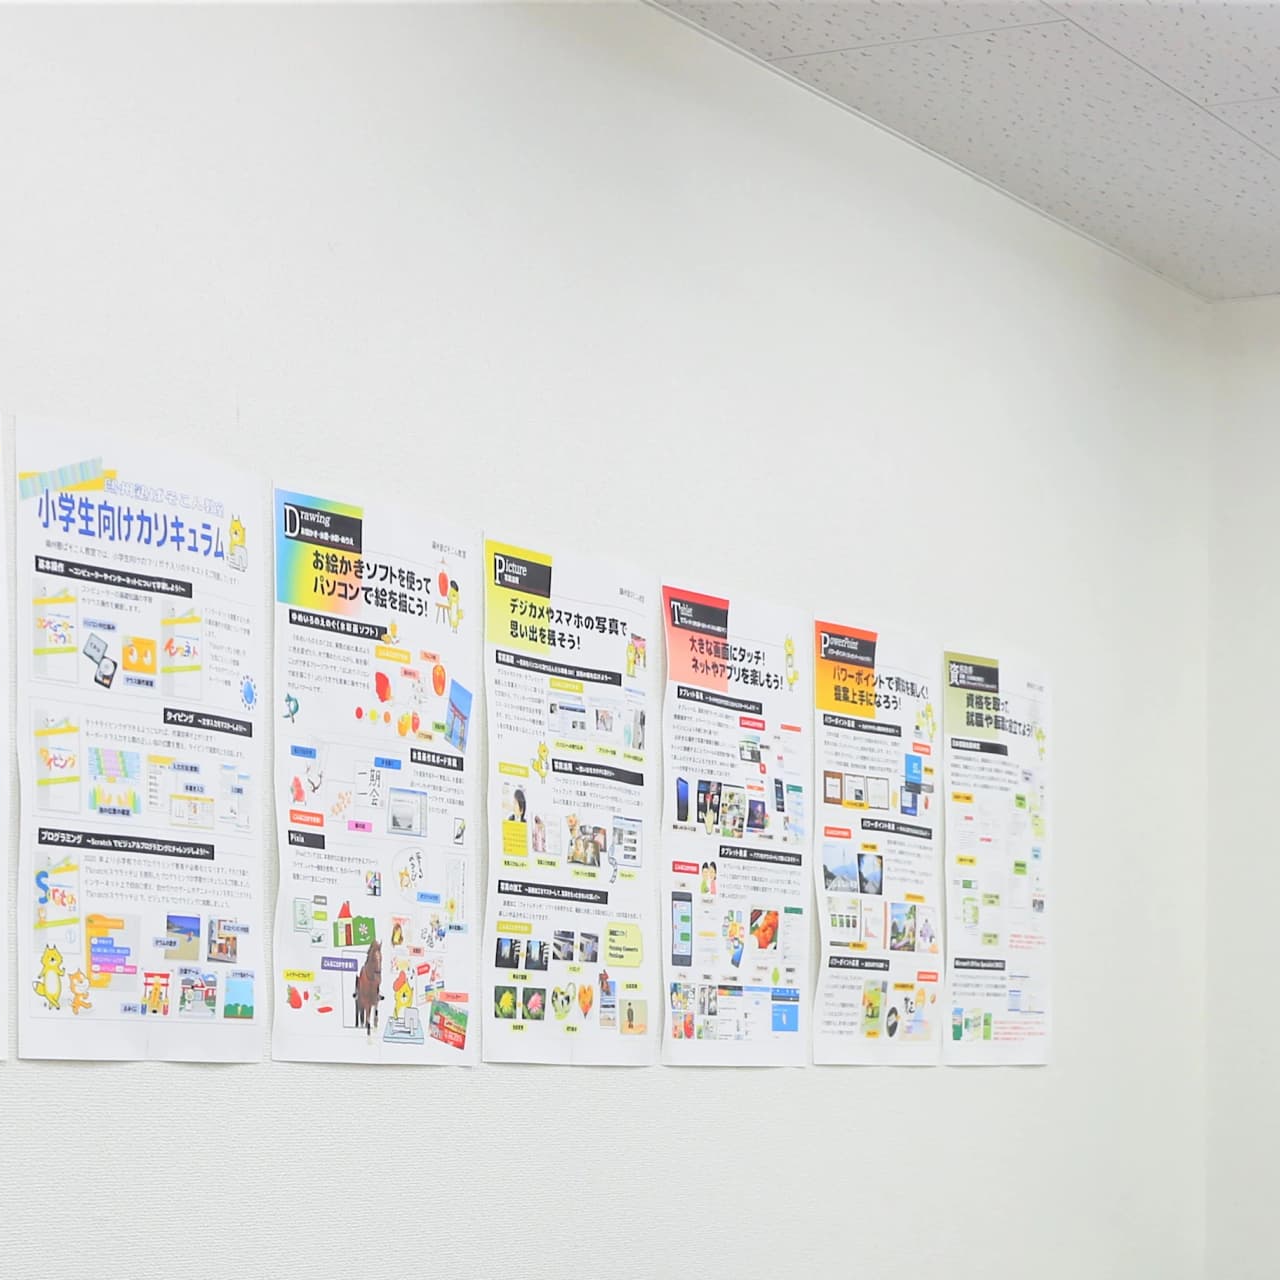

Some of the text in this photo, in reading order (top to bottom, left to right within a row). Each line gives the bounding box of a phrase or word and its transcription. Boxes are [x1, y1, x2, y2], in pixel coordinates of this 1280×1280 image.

[36, 487, 225, 560] 小学生向けカリキュラム
[284, 504, 331, 537] Drawing
[312, 550, 432, 595] お絵かきソフトを使って
[494, 554, 528, 585] Picture
[313, 575, 429, 618] パソコンで絵を描こう!
[509, 597, 628, 637] デジカメやスマホの写真で
[510, 620, 582, 651] 思い出を残そう!
[688, 635, 766, 667] 大きな画面にタッチ!
[691, 657, 784, 691] ネットやアプリを楽しもう!
[165, 710, 195, 725] タイピング
[41, 830, 83, 844] プログラミング
